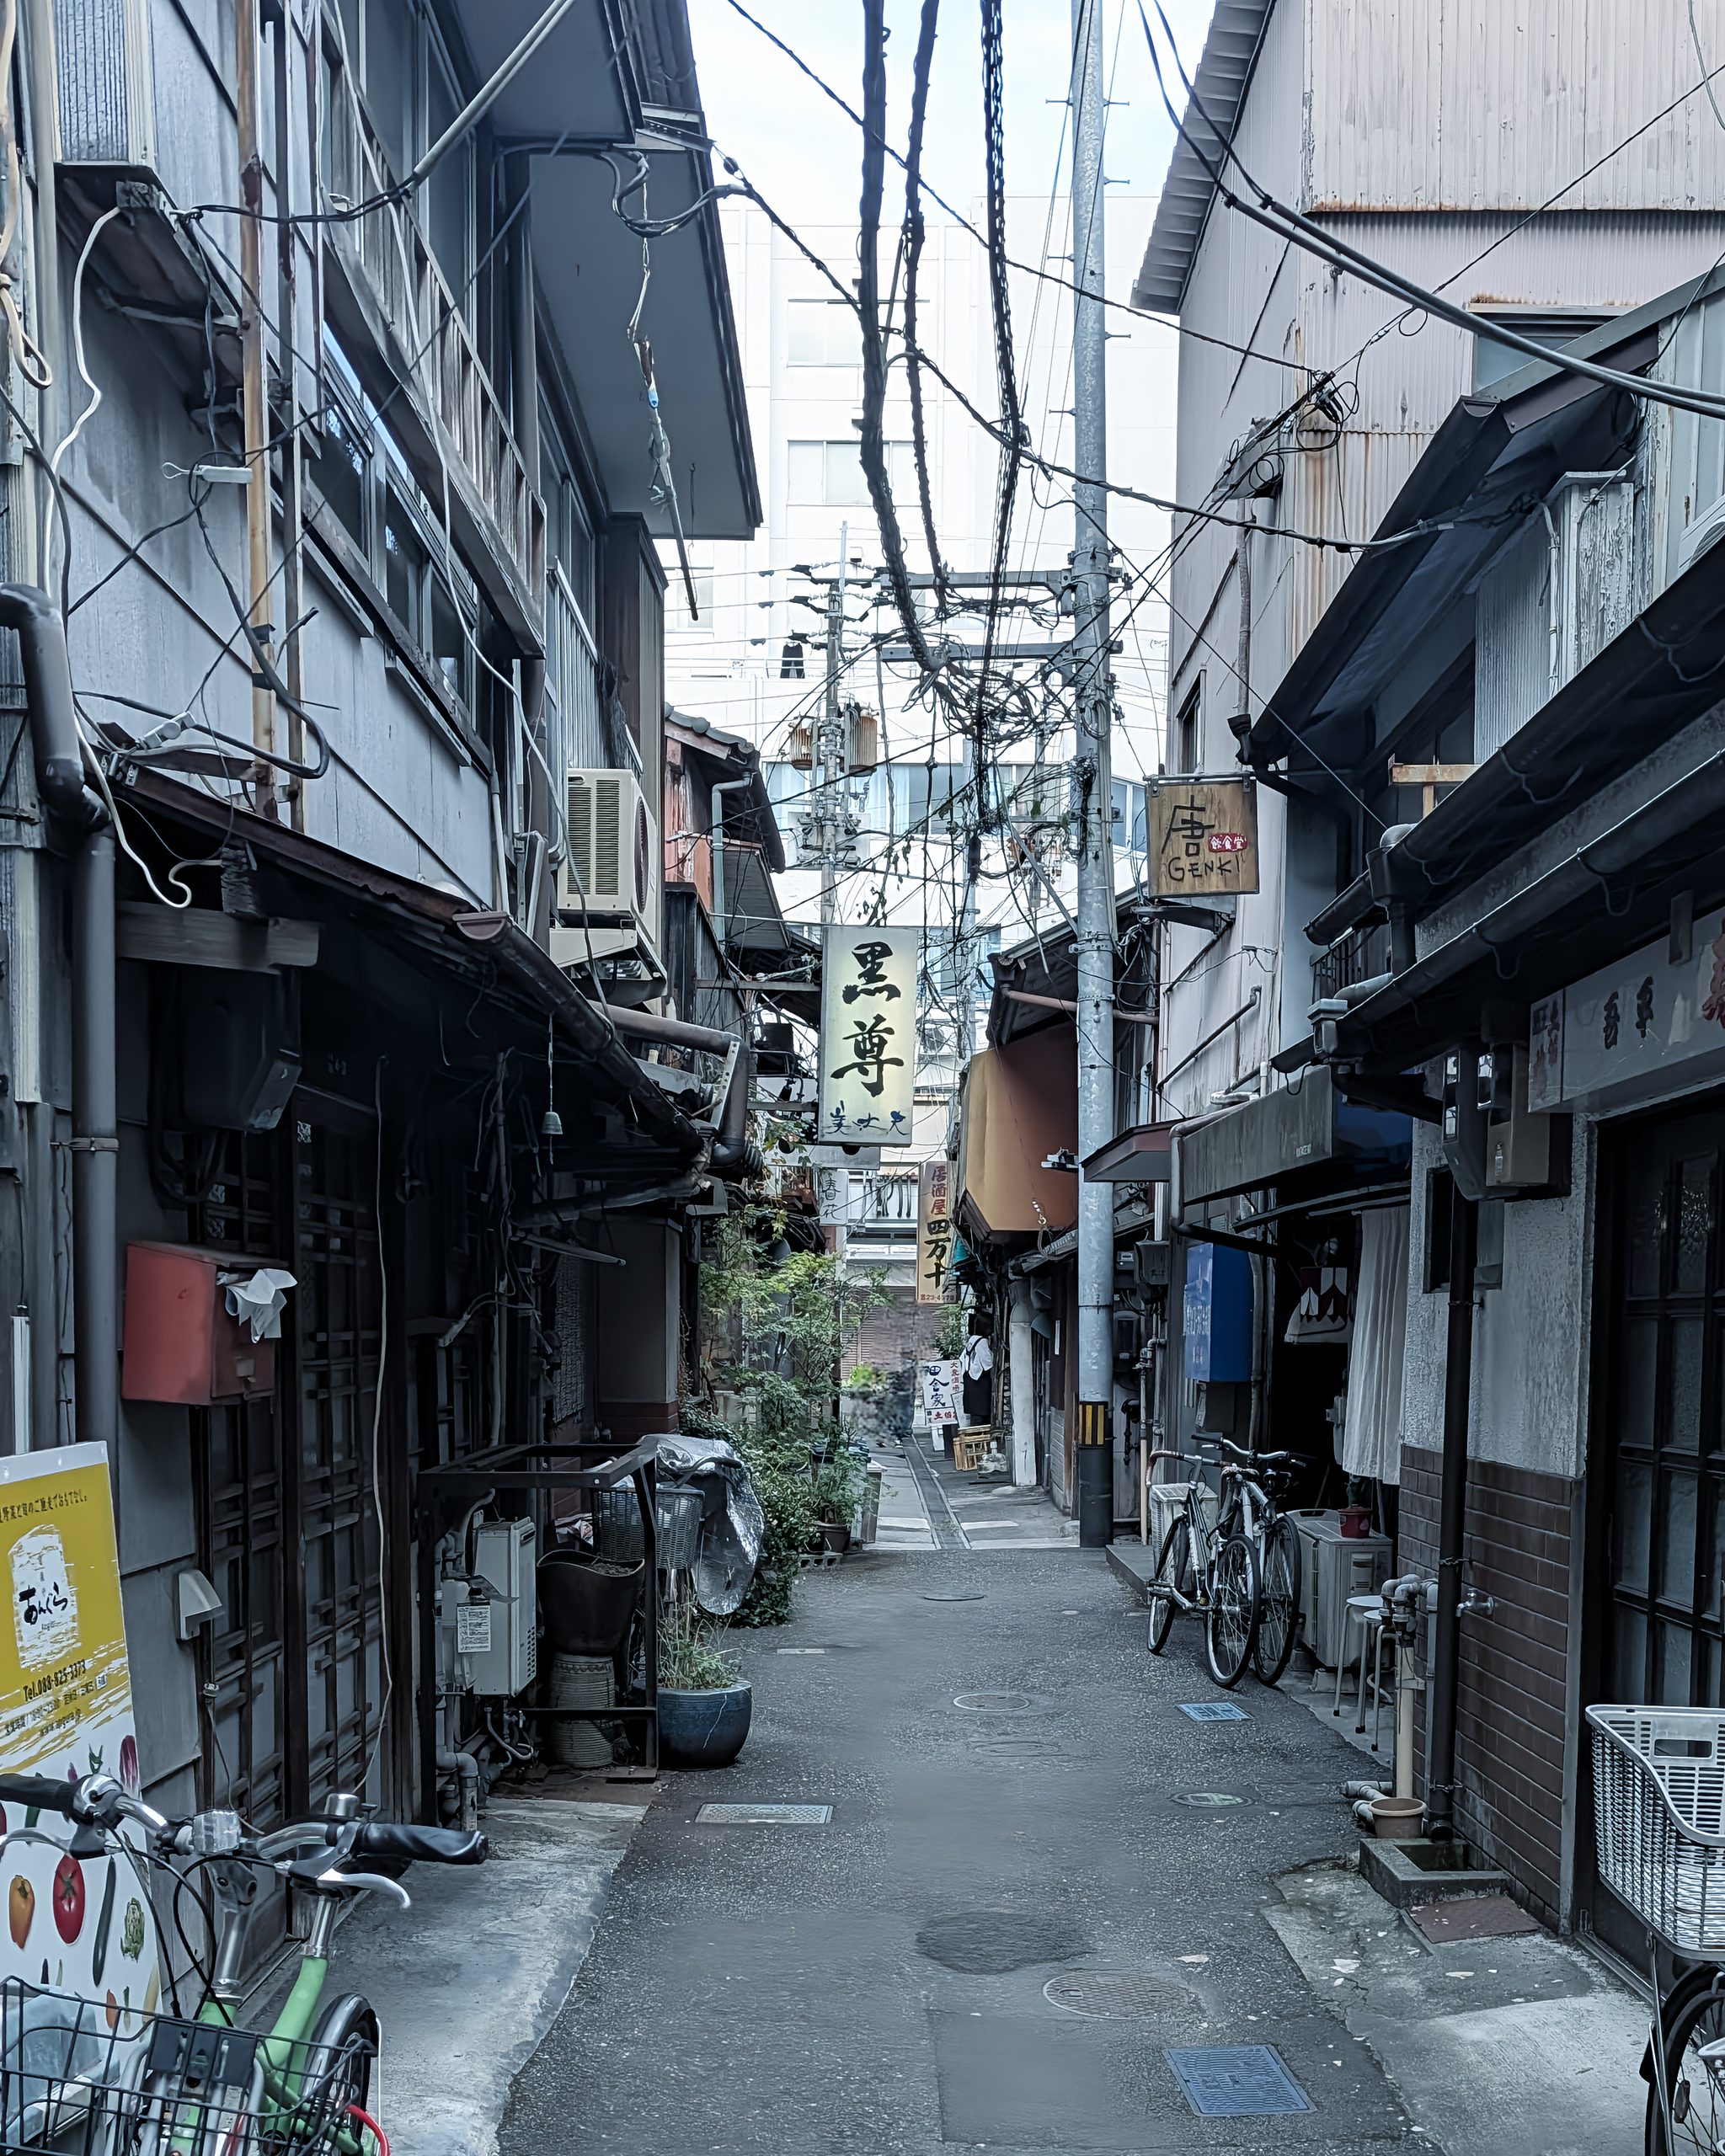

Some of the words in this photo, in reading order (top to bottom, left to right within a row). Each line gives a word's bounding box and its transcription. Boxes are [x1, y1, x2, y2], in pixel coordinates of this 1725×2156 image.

[1162, 794, 1215, 857] 唐
[1167, 855, 1241, 882] GENKI
[830, 941, 905, 1098] 黒尊
[931, 1165, 948, 1216] 居酒屋
[924, 1219, 951, 1289] 四万十
[929, 1365, 949, 1406] 田舎家
